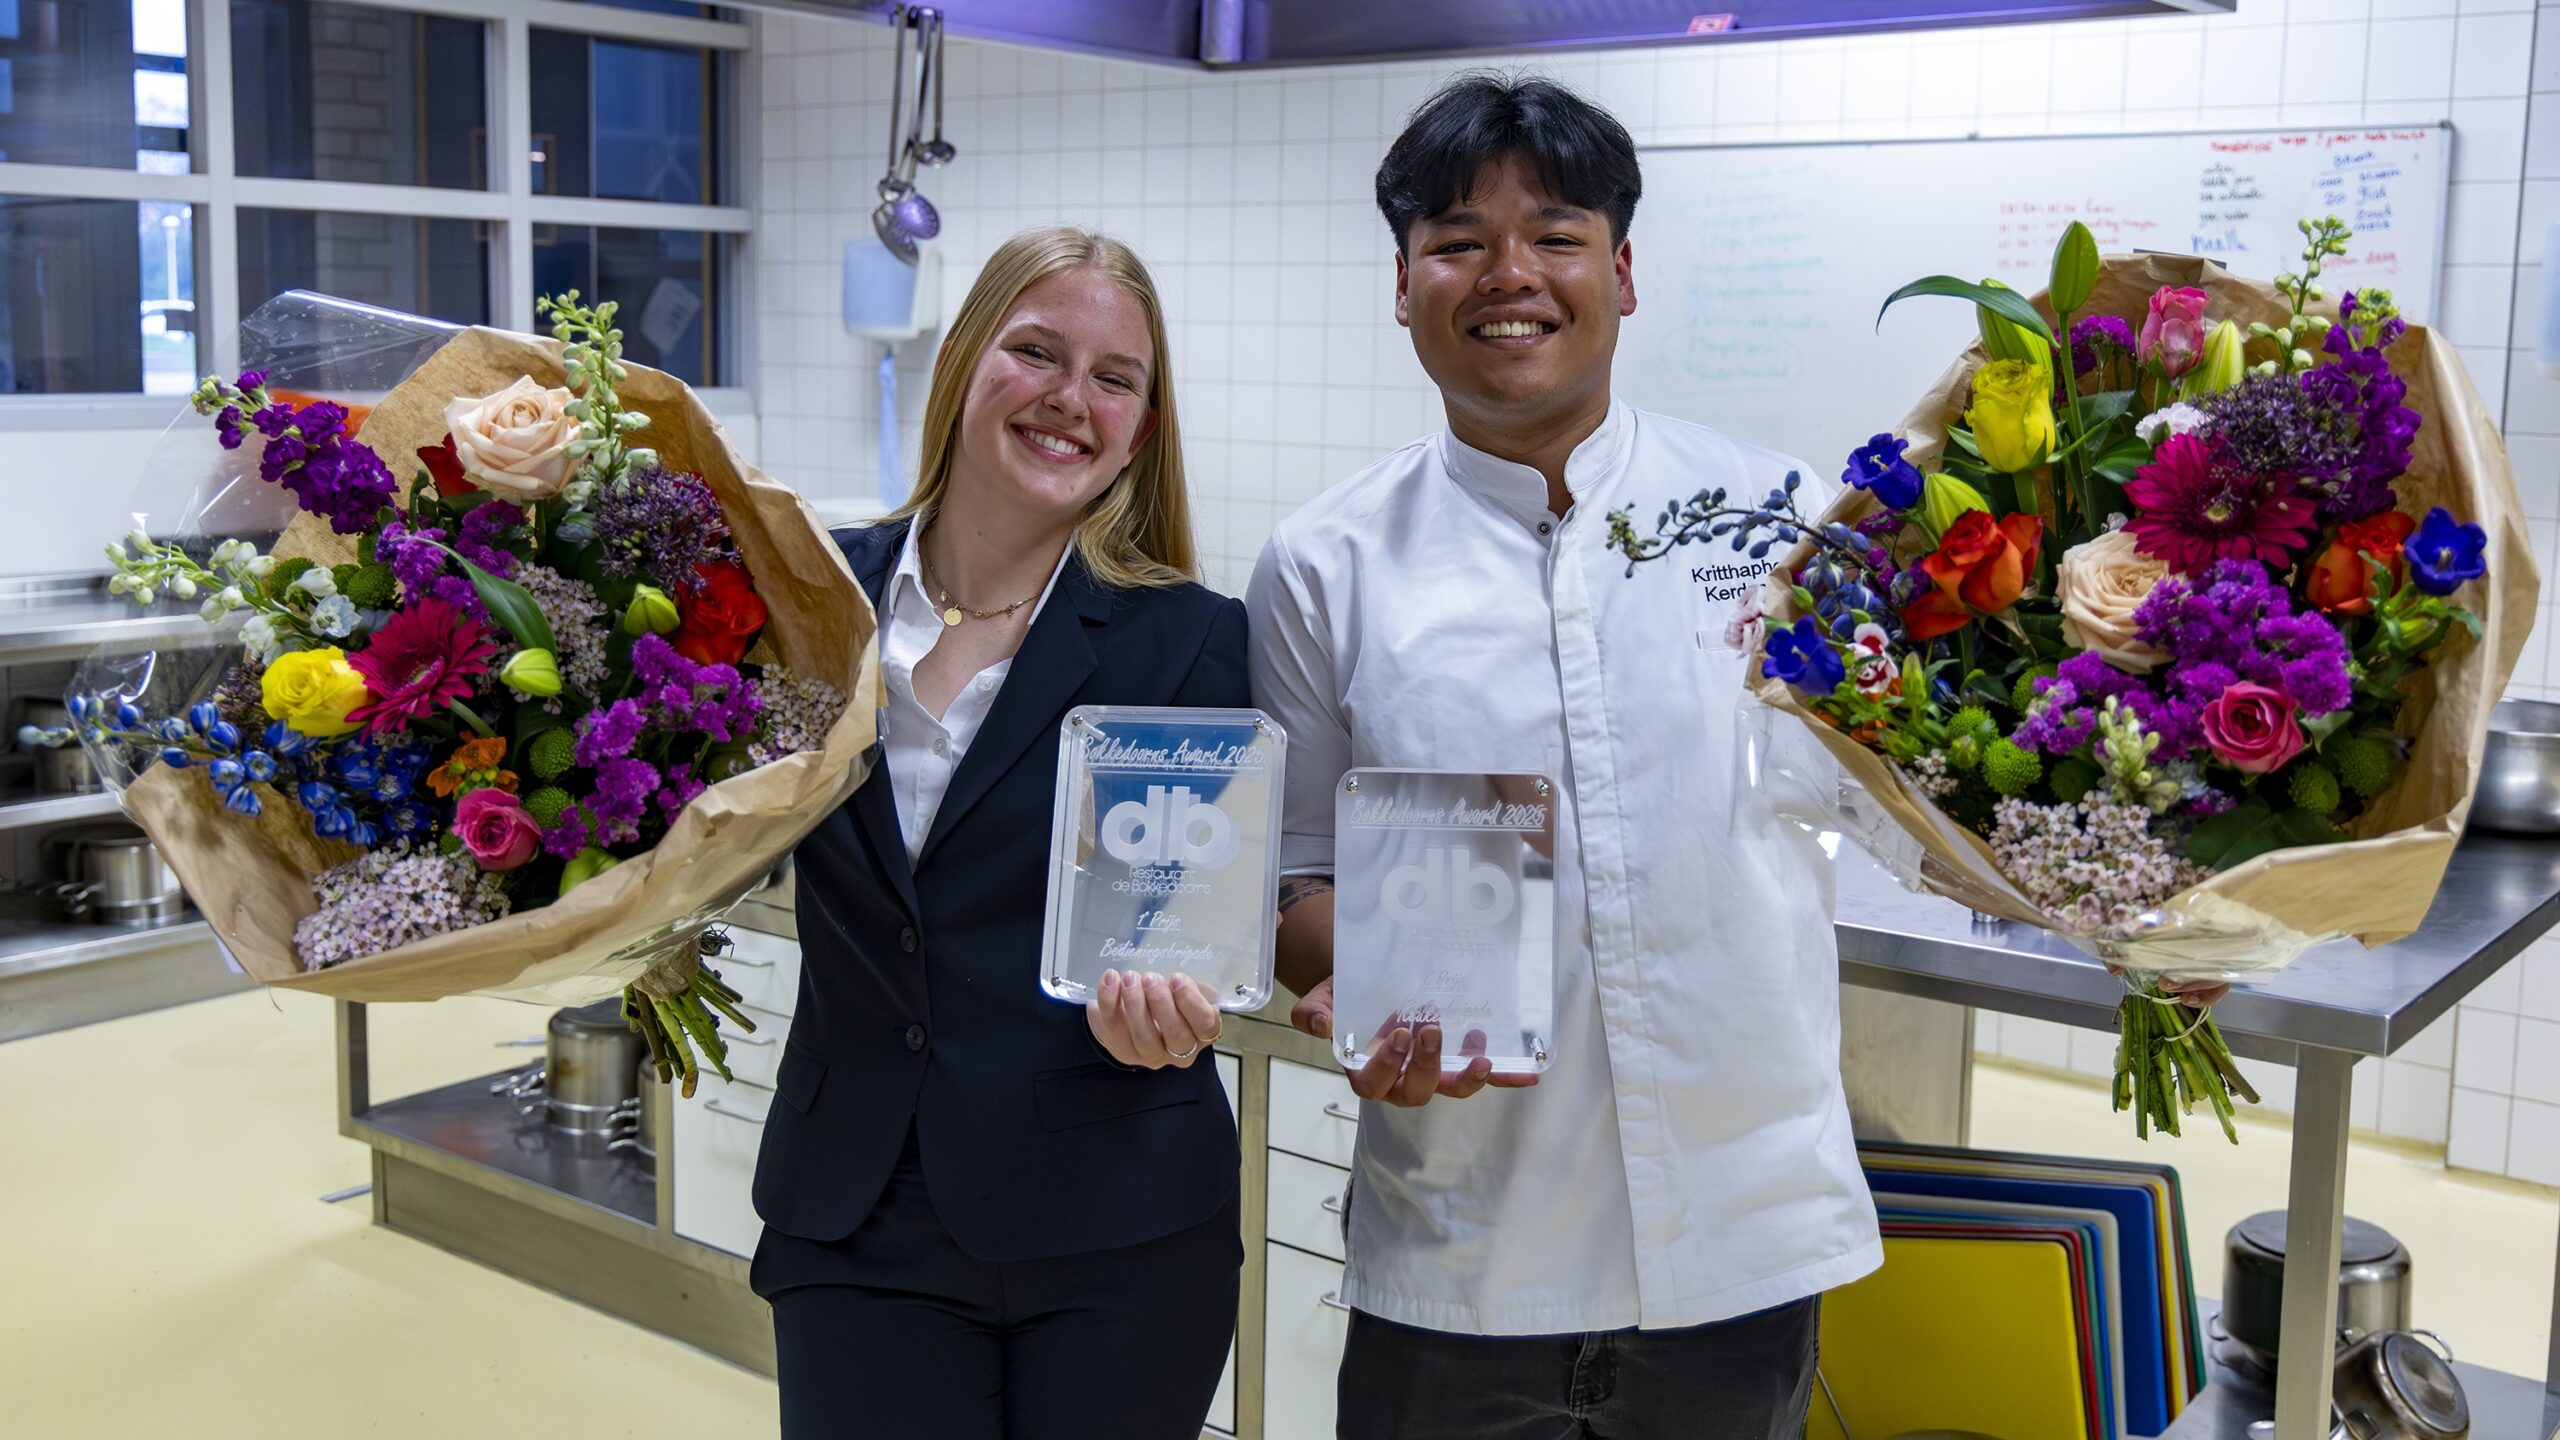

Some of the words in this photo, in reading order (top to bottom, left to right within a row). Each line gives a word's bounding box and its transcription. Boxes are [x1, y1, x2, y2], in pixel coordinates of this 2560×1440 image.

[1172, 738, 1224, 764] Award
[1224, 745, 1265, 764] 2025
[1102, 785, 1232, 866] db
[1449, 797, 1502, 826] Award
[1502, 803, 1547, 827] 2025
[1112, 879, 1130, 892] de
[1381, 845, 1514, 927] db
[1150, 911, 1181, 932] Prijs
